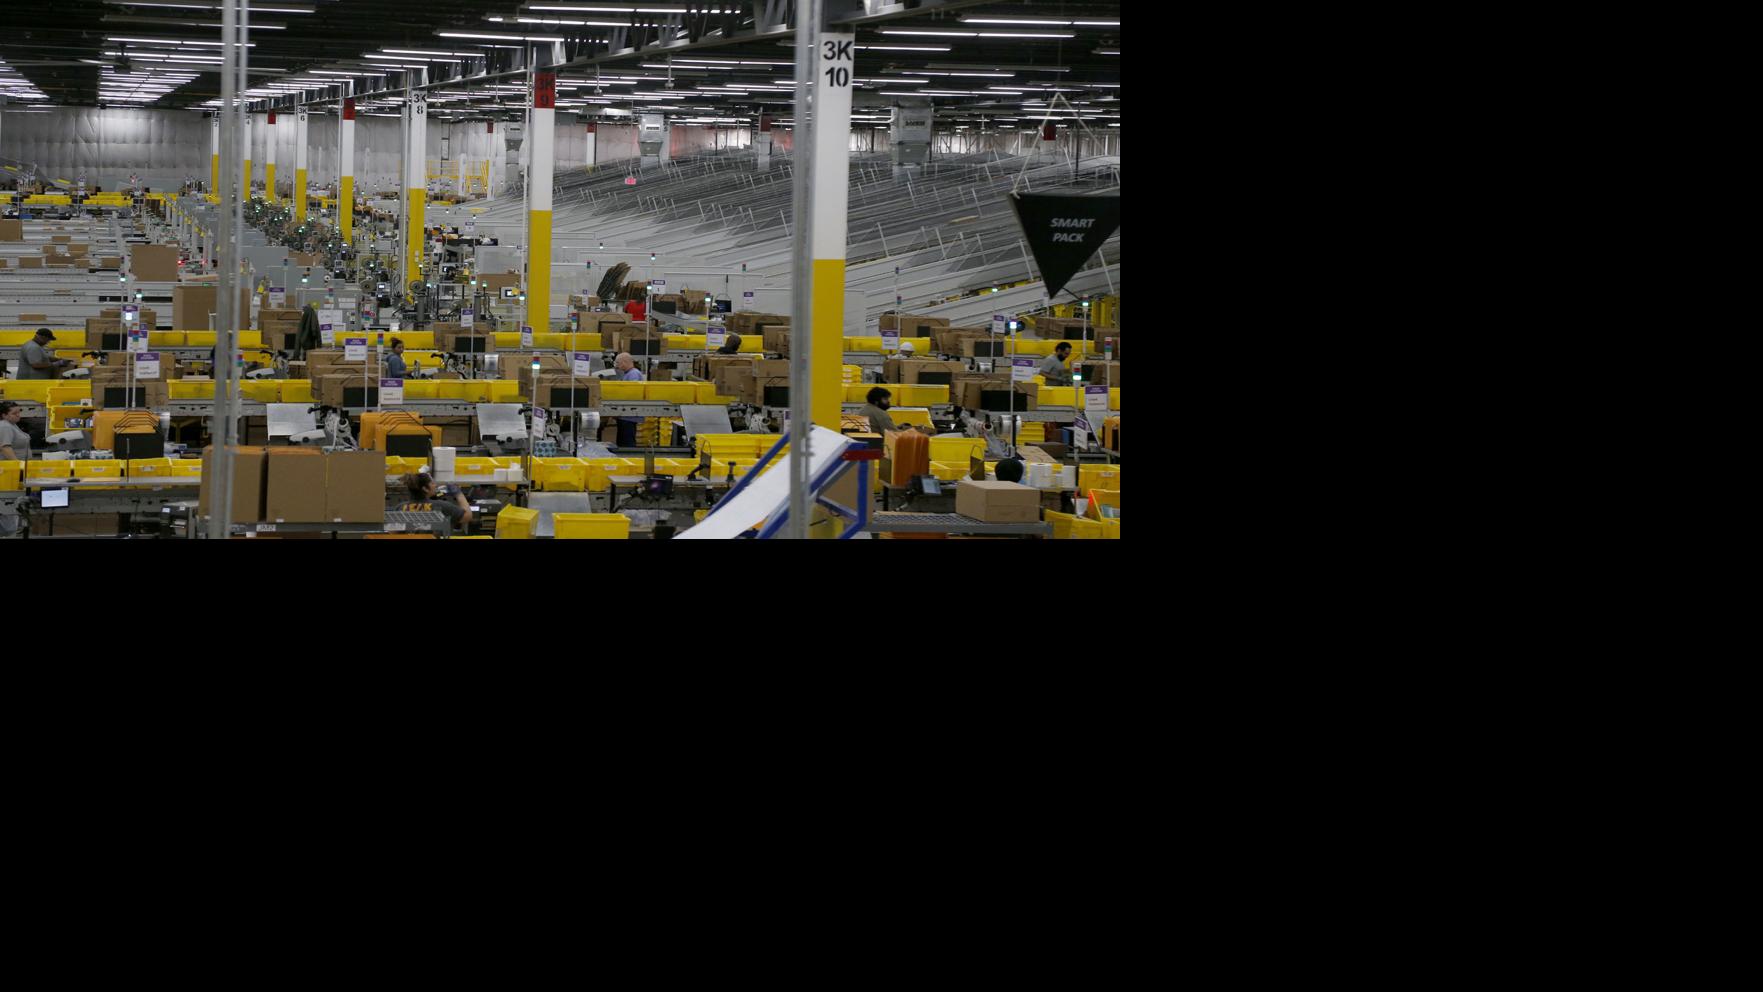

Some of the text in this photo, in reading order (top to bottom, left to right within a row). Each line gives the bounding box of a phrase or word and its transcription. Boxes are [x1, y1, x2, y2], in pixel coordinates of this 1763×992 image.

[823, 41, 852, 61] 3K
[825, 67, 849, 87] 10
[413, 94, 427, 103] 3K
[416, 105, 423, 114] 8
[1049, 218, 1096, 228] SMART
[1052, 233, 1085, 242] PACK
